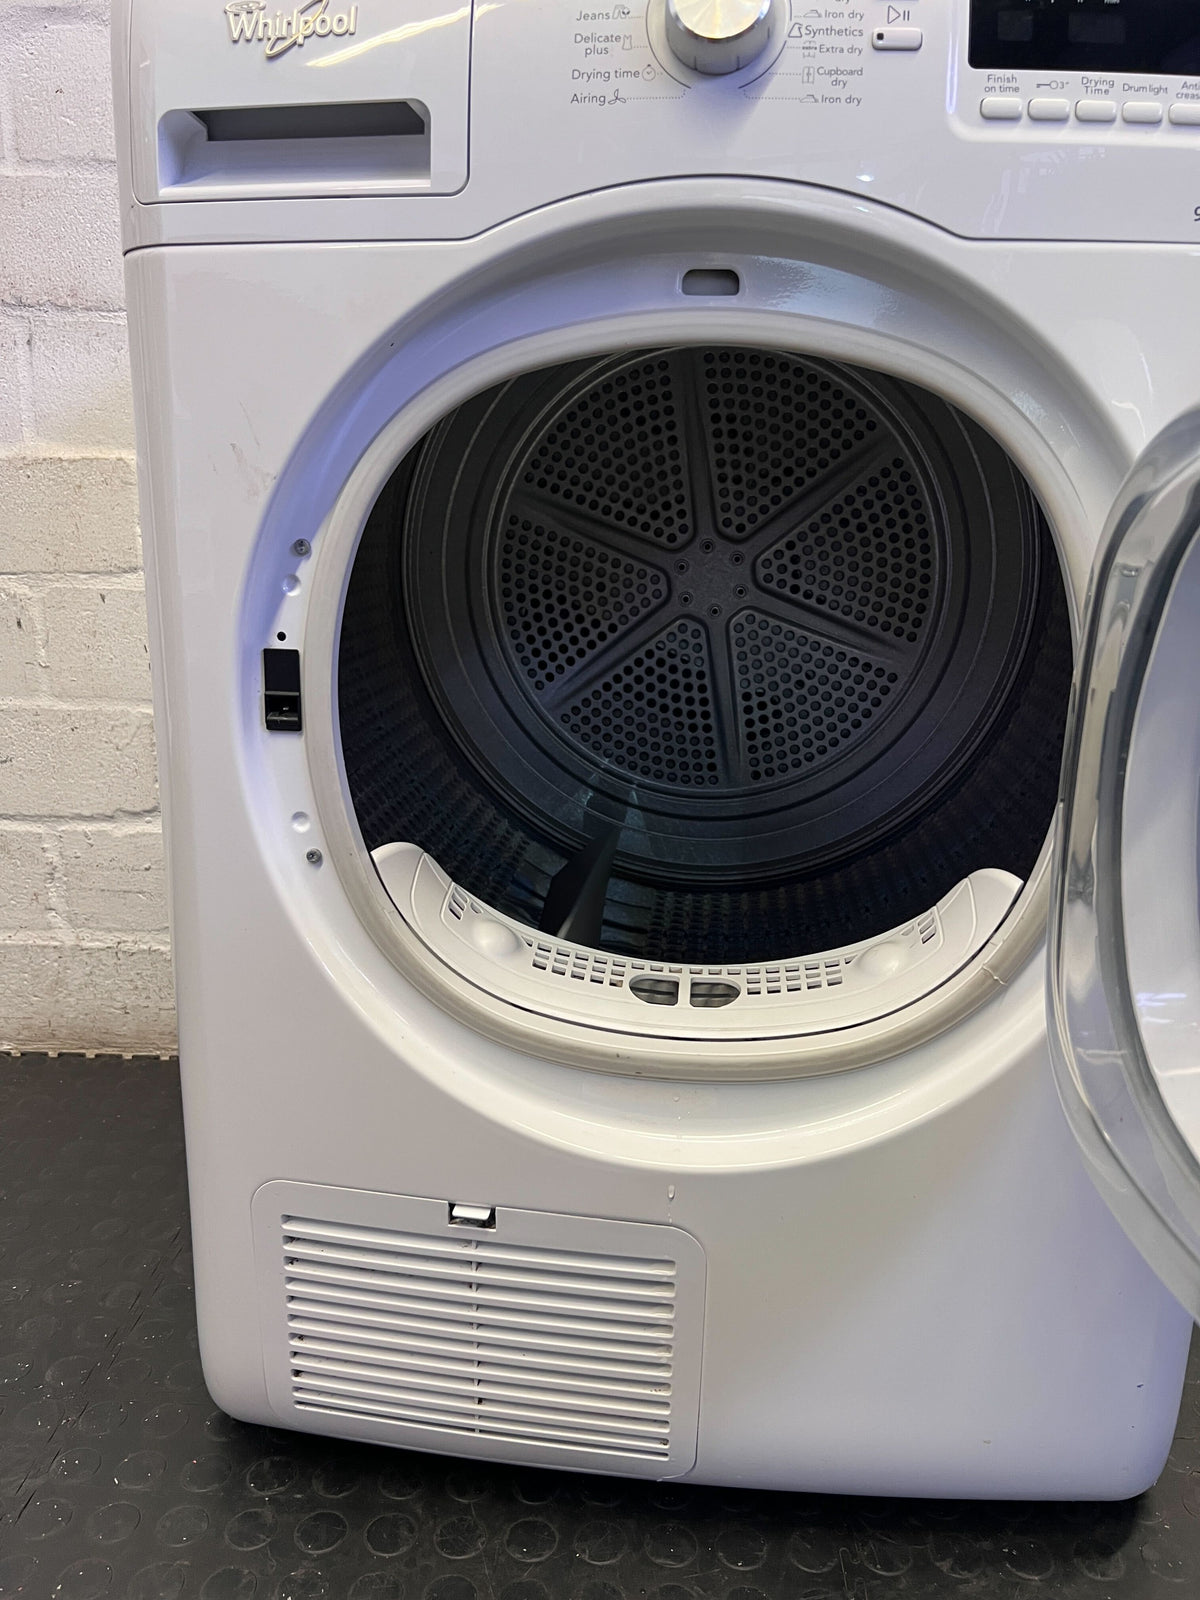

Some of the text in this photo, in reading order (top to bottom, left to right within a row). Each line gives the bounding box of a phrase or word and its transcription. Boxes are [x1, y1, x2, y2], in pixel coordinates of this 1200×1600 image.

[576, 10, 611, 21] Jeans
[825, 10, 864, 21] Iron dry
[225, 4, 358, 46] Whirlpool
[805, 25, 864, 38] Synthetics
[574, 33, 621, 43] Delicate
[585, 44, 609, 58] plus
[819, 44, 863, 56] Extra dry
[572, 68, 640, 83] Drying time
[817, 66, 864, 78] Cupboard
[831, 78, 847, 89] dry
[987, 74, 1018, 84] Finish
[1081, 76, 1115, 89] Drying
[999, 84, 1020, 93] time
[1084, 86, 1110, 96] Time
[1122, 83, 1168, 96] Drum light
[570, 93, 606, 106] Airing
[821, 95, 862, 107] Iron dry
[1175, 92, 1200, 100] creas
